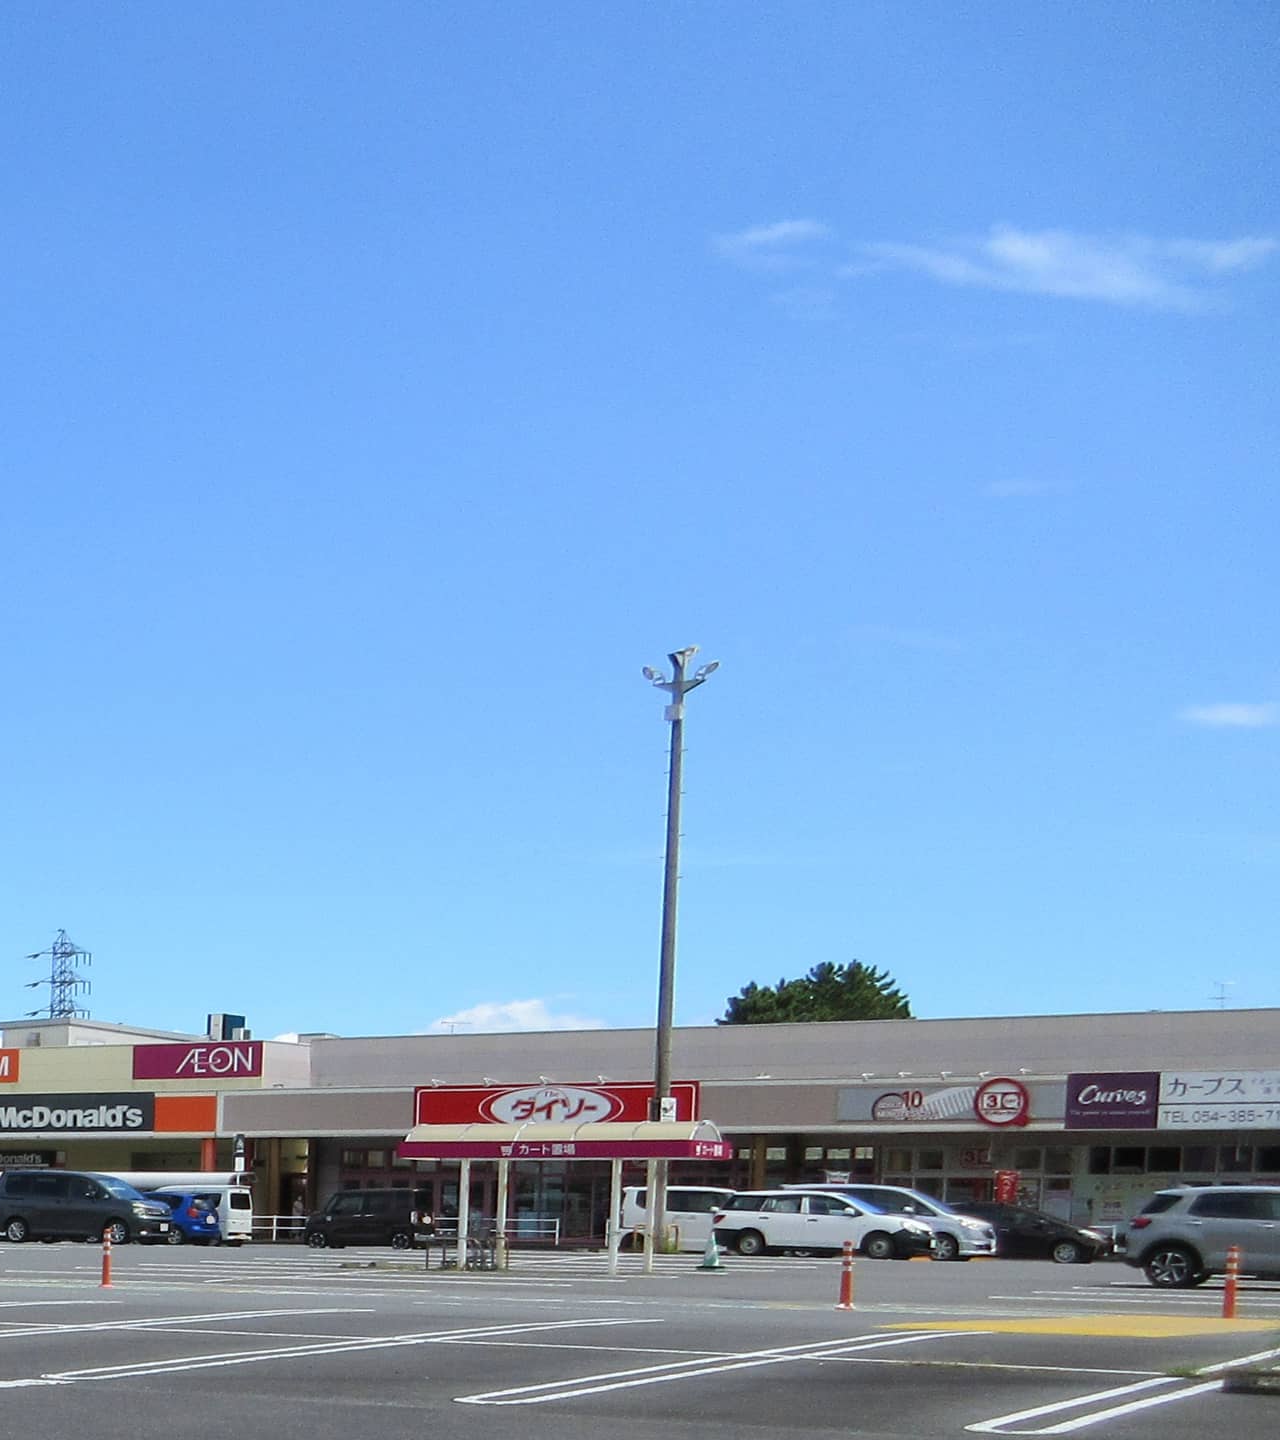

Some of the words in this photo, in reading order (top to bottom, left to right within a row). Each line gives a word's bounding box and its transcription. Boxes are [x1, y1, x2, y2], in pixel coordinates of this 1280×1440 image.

[1078, 1084, 1147, 1105] Curves
[511, 1098, 598, 1121] ダイソー
[1163, 1111, 1189, 1123] TEL
